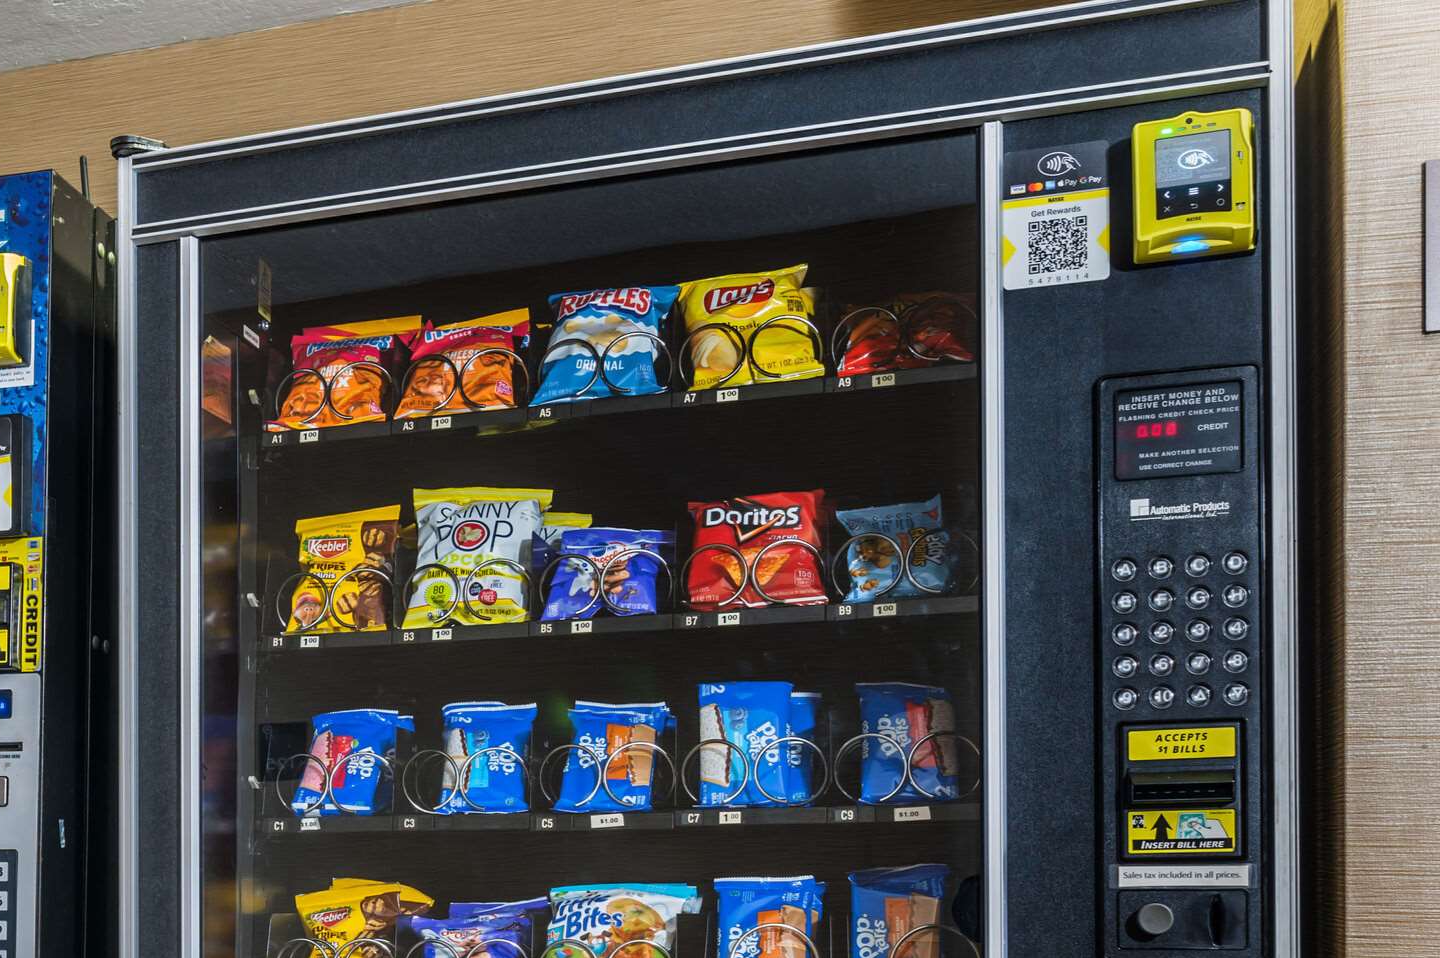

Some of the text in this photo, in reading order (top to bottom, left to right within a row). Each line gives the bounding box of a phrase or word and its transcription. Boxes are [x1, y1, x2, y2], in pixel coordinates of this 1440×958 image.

[1031, 205, 1081, 218] Get Rewards
[560, 286, 651, 316] RUFFLES
[838, 377, 852, 388] A9
[683, 392, 696, 404] A7
[1131, 388, 1225, 403] INSERT MONEY AND
[1118, 394, 1239, 412] RECEIVE CHANGE BELOW
[539, 408, 551, 418] A5
[1158, 410, 1186, 419] CREDIT
[1188, 407, 1214, 416] CHECK
[402, 421, 414, 431] A3
[1197, 422, 1229, 431] CREDIT
[271, 434, 282, 444] A1
[1161, 449, 1196, 457] ANOTHER
[1198, 445, 1239, 454] SELECTION
[1138, 463, 1152, 471] USE
[440, 502, 519, 524] SKINNY
[1150, 500, 1230, 515] Automatic Products
[705, 504, 800, 528] Doritos
[436, 519, 514, 561] POP
[309, 538, 348, 555] Keebler
[432, 585, 445, 595] 80
[839, 605, 852, 616] B9
[686, 616, 698, 627] B7
[25, 594, 38, 667] CREDIT
[540, 622, 552, 634] B5
[273, 636, 283, 647] B1
[403, 631, 415, 642] B3
[1155, 732, 1208, 743] ACCEPTS
[1157, 744, 1206, 754] $1 BILLS
[687, 813, 700, 823] C7
[840, 810, 854, 821] C9
[273, 821, 284, 831] C1
[403, 818, 415, 829] C3
[541, 818, 553, 829] C5
[1140, 840, 1225, 850] INSERT BILL HERE
[1122, 870, 1242, 881] Sales tax included in all prices.
[565, 905, 624, 938] Bites
